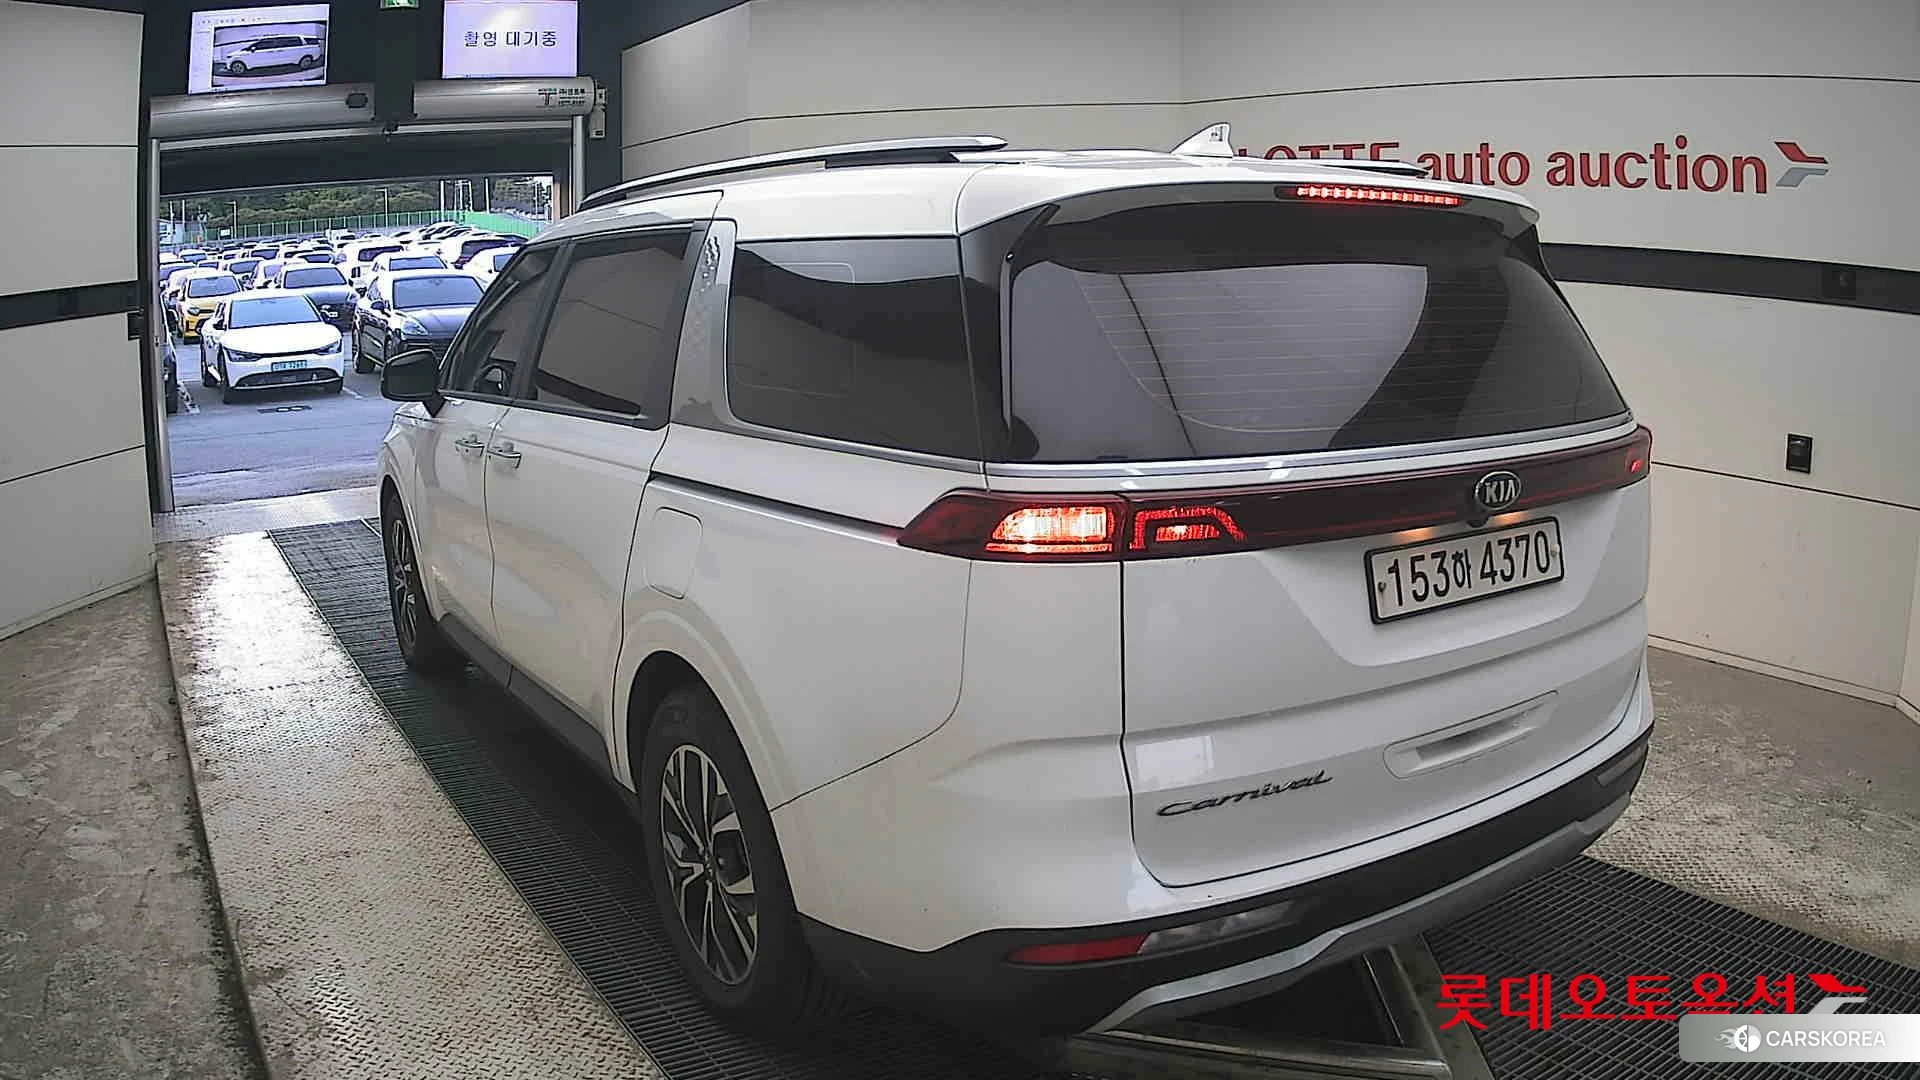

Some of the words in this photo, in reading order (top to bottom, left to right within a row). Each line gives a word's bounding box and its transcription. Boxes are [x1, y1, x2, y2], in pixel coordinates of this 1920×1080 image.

[505, 30, 558, 47] 대기중
[1417, 141, 1529, 187] auto
[1546, 134, 1768, 194] auction
[1484, 479, 1517, 503] KIA
[1387, 549, 1472, 607] 153하
[1480, 530, 1551, 586] 4370
[1156, 769, 1334, 817] Carnival
